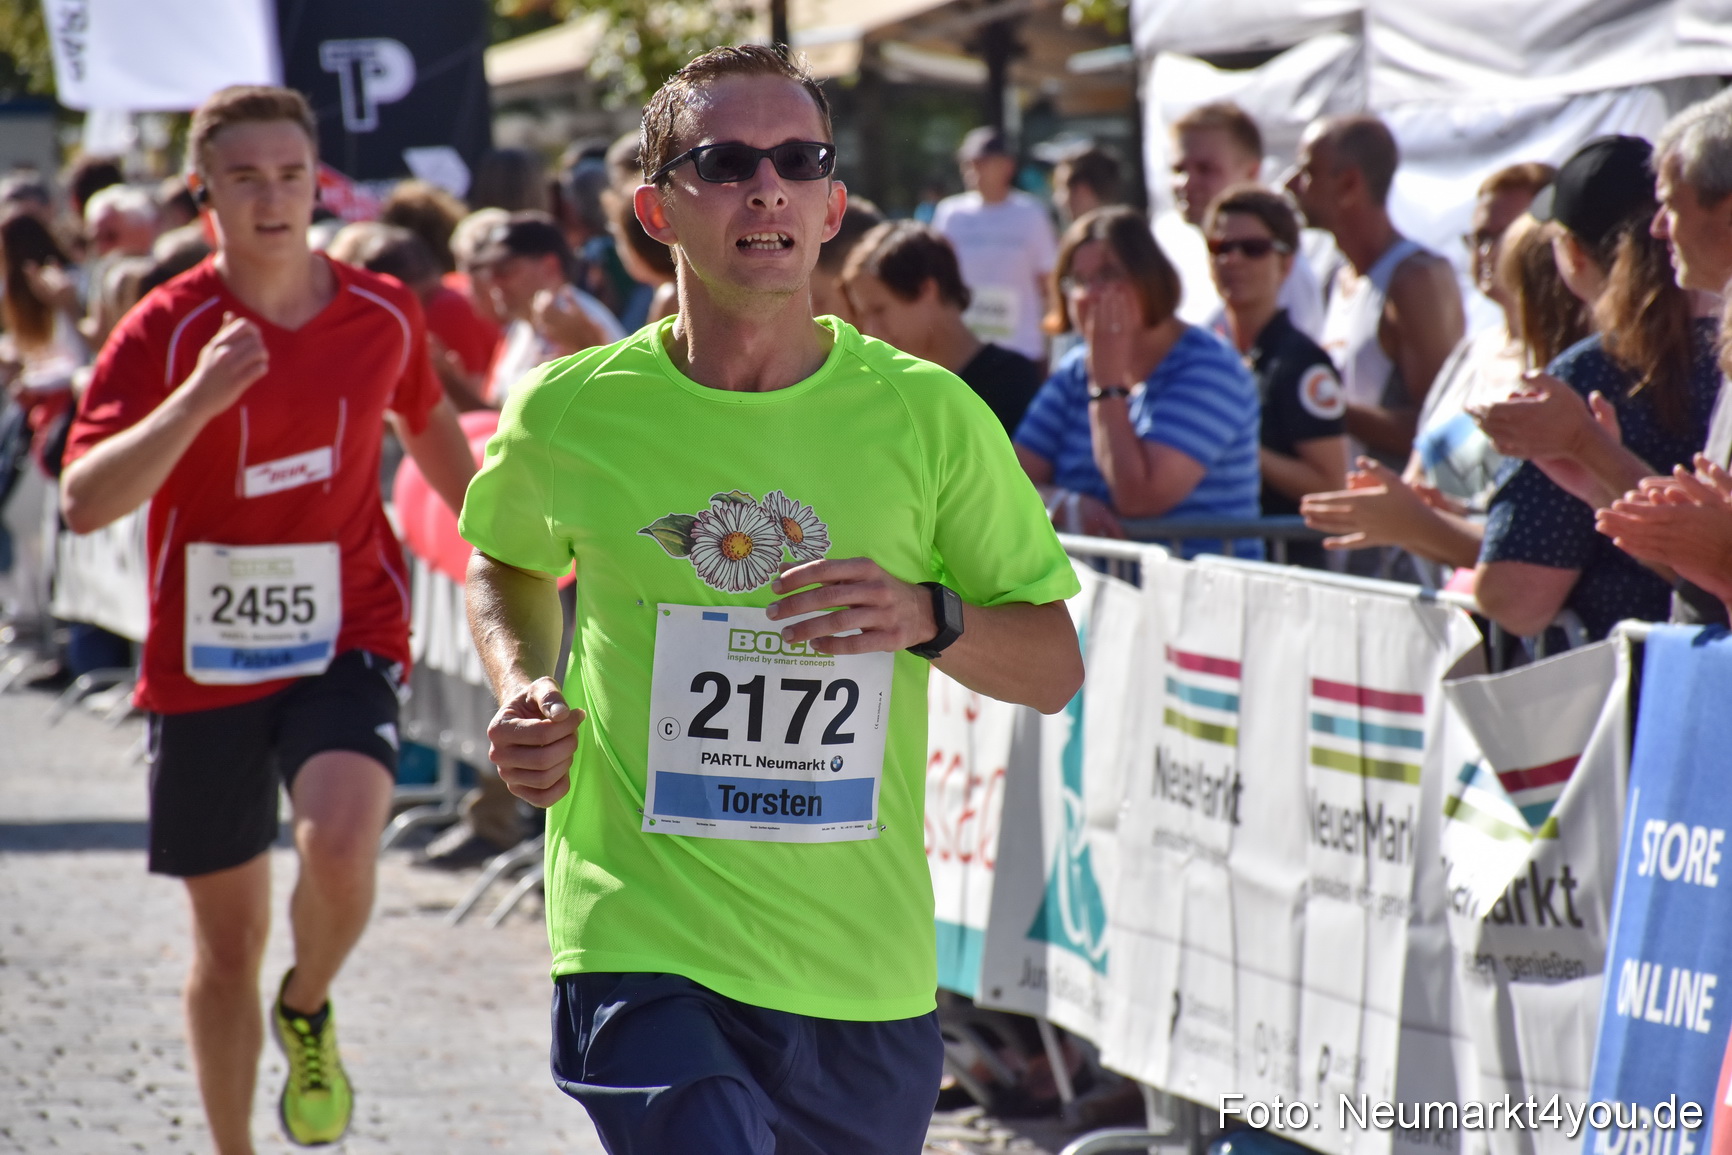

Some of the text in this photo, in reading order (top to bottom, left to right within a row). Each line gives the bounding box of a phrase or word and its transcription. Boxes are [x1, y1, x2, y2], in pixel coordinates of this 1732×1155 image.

[211, 583, 316, 626] 2455
[727, 653, 836, 668] inspired by smart concepts
[687, 671, 860, 746] 2172
[701, 752, 826, 772] PARTL Neumarkt
[717, 784, 822, 817] Torsten
[1637, 818, 1726, 888] STORE
[1616, 957, 1718, 1034] ONLINE
